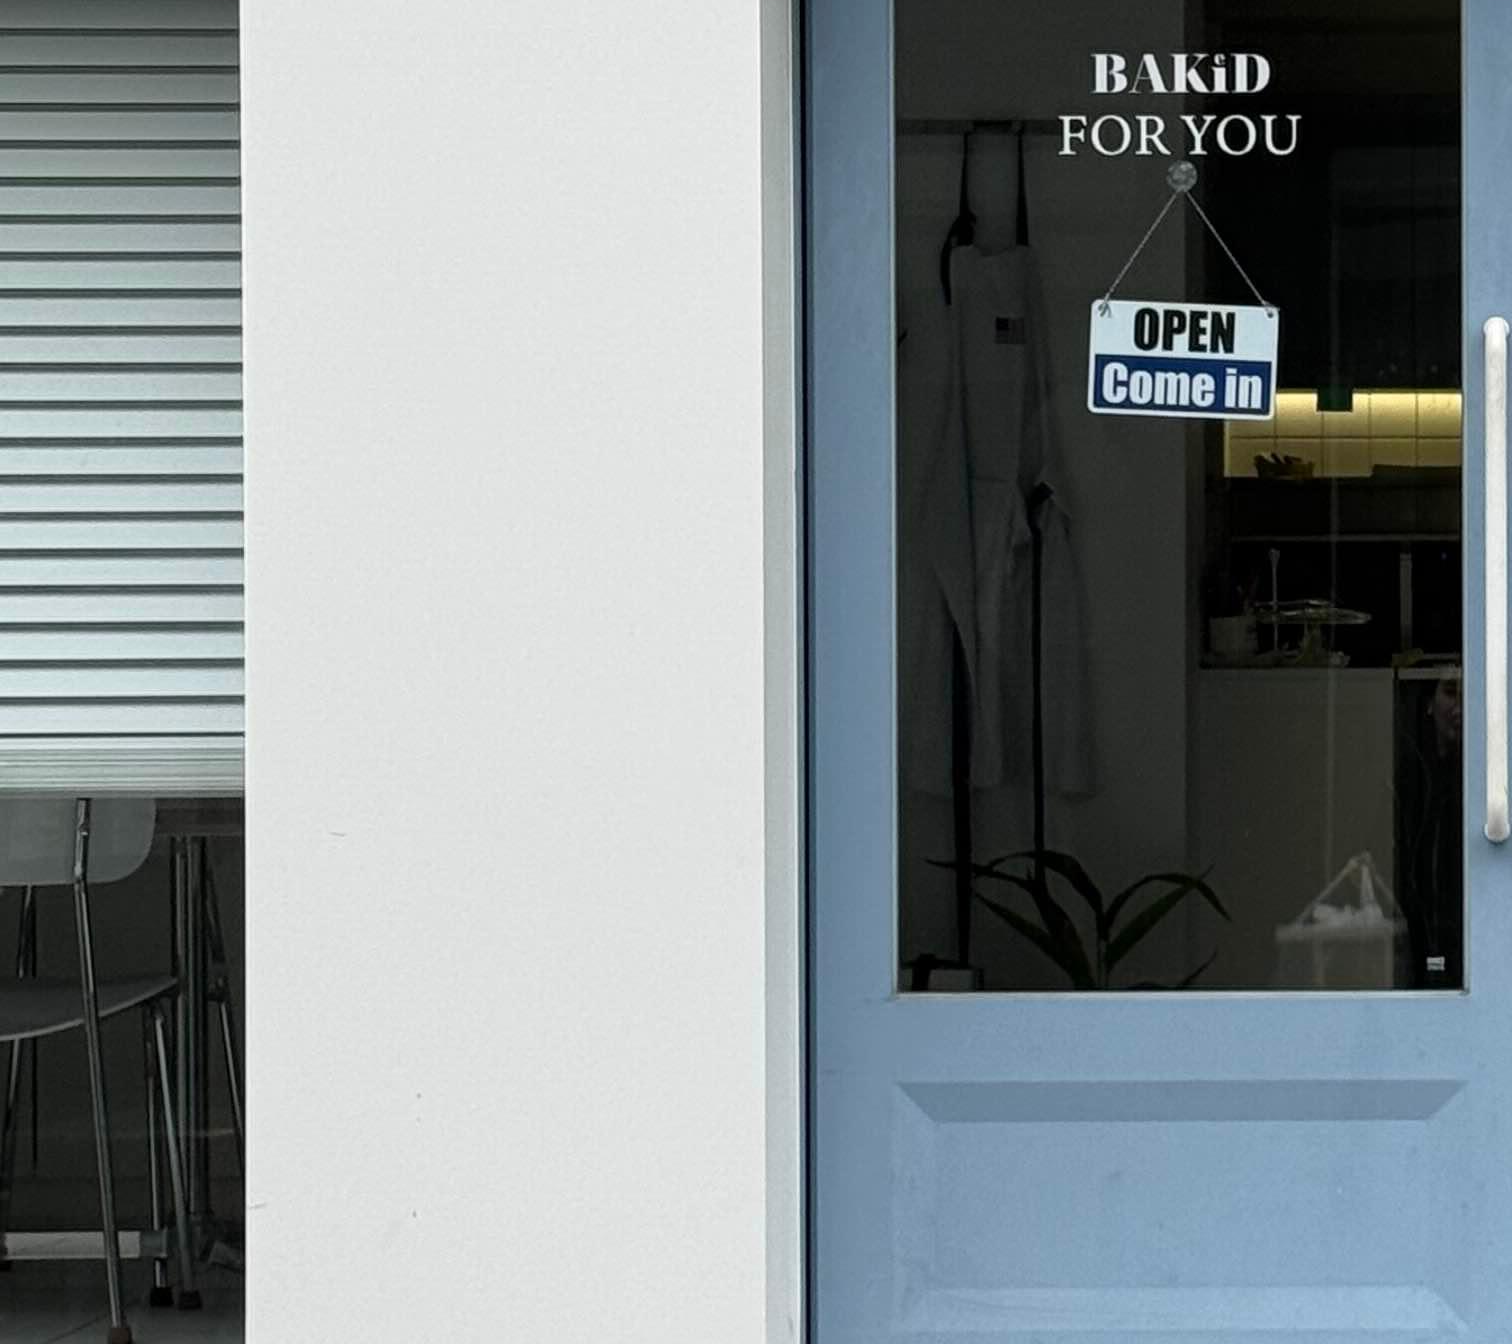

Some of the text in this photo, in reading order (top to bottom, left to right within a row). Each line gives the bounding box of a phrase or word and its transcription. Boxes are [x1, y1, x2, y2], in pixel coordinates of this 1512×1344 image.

[1058, 115, 1302, 156] FOR YOU
[1133, 307, 1236, 354] OPEN
[1101, 362, 1262, 409] Come in
